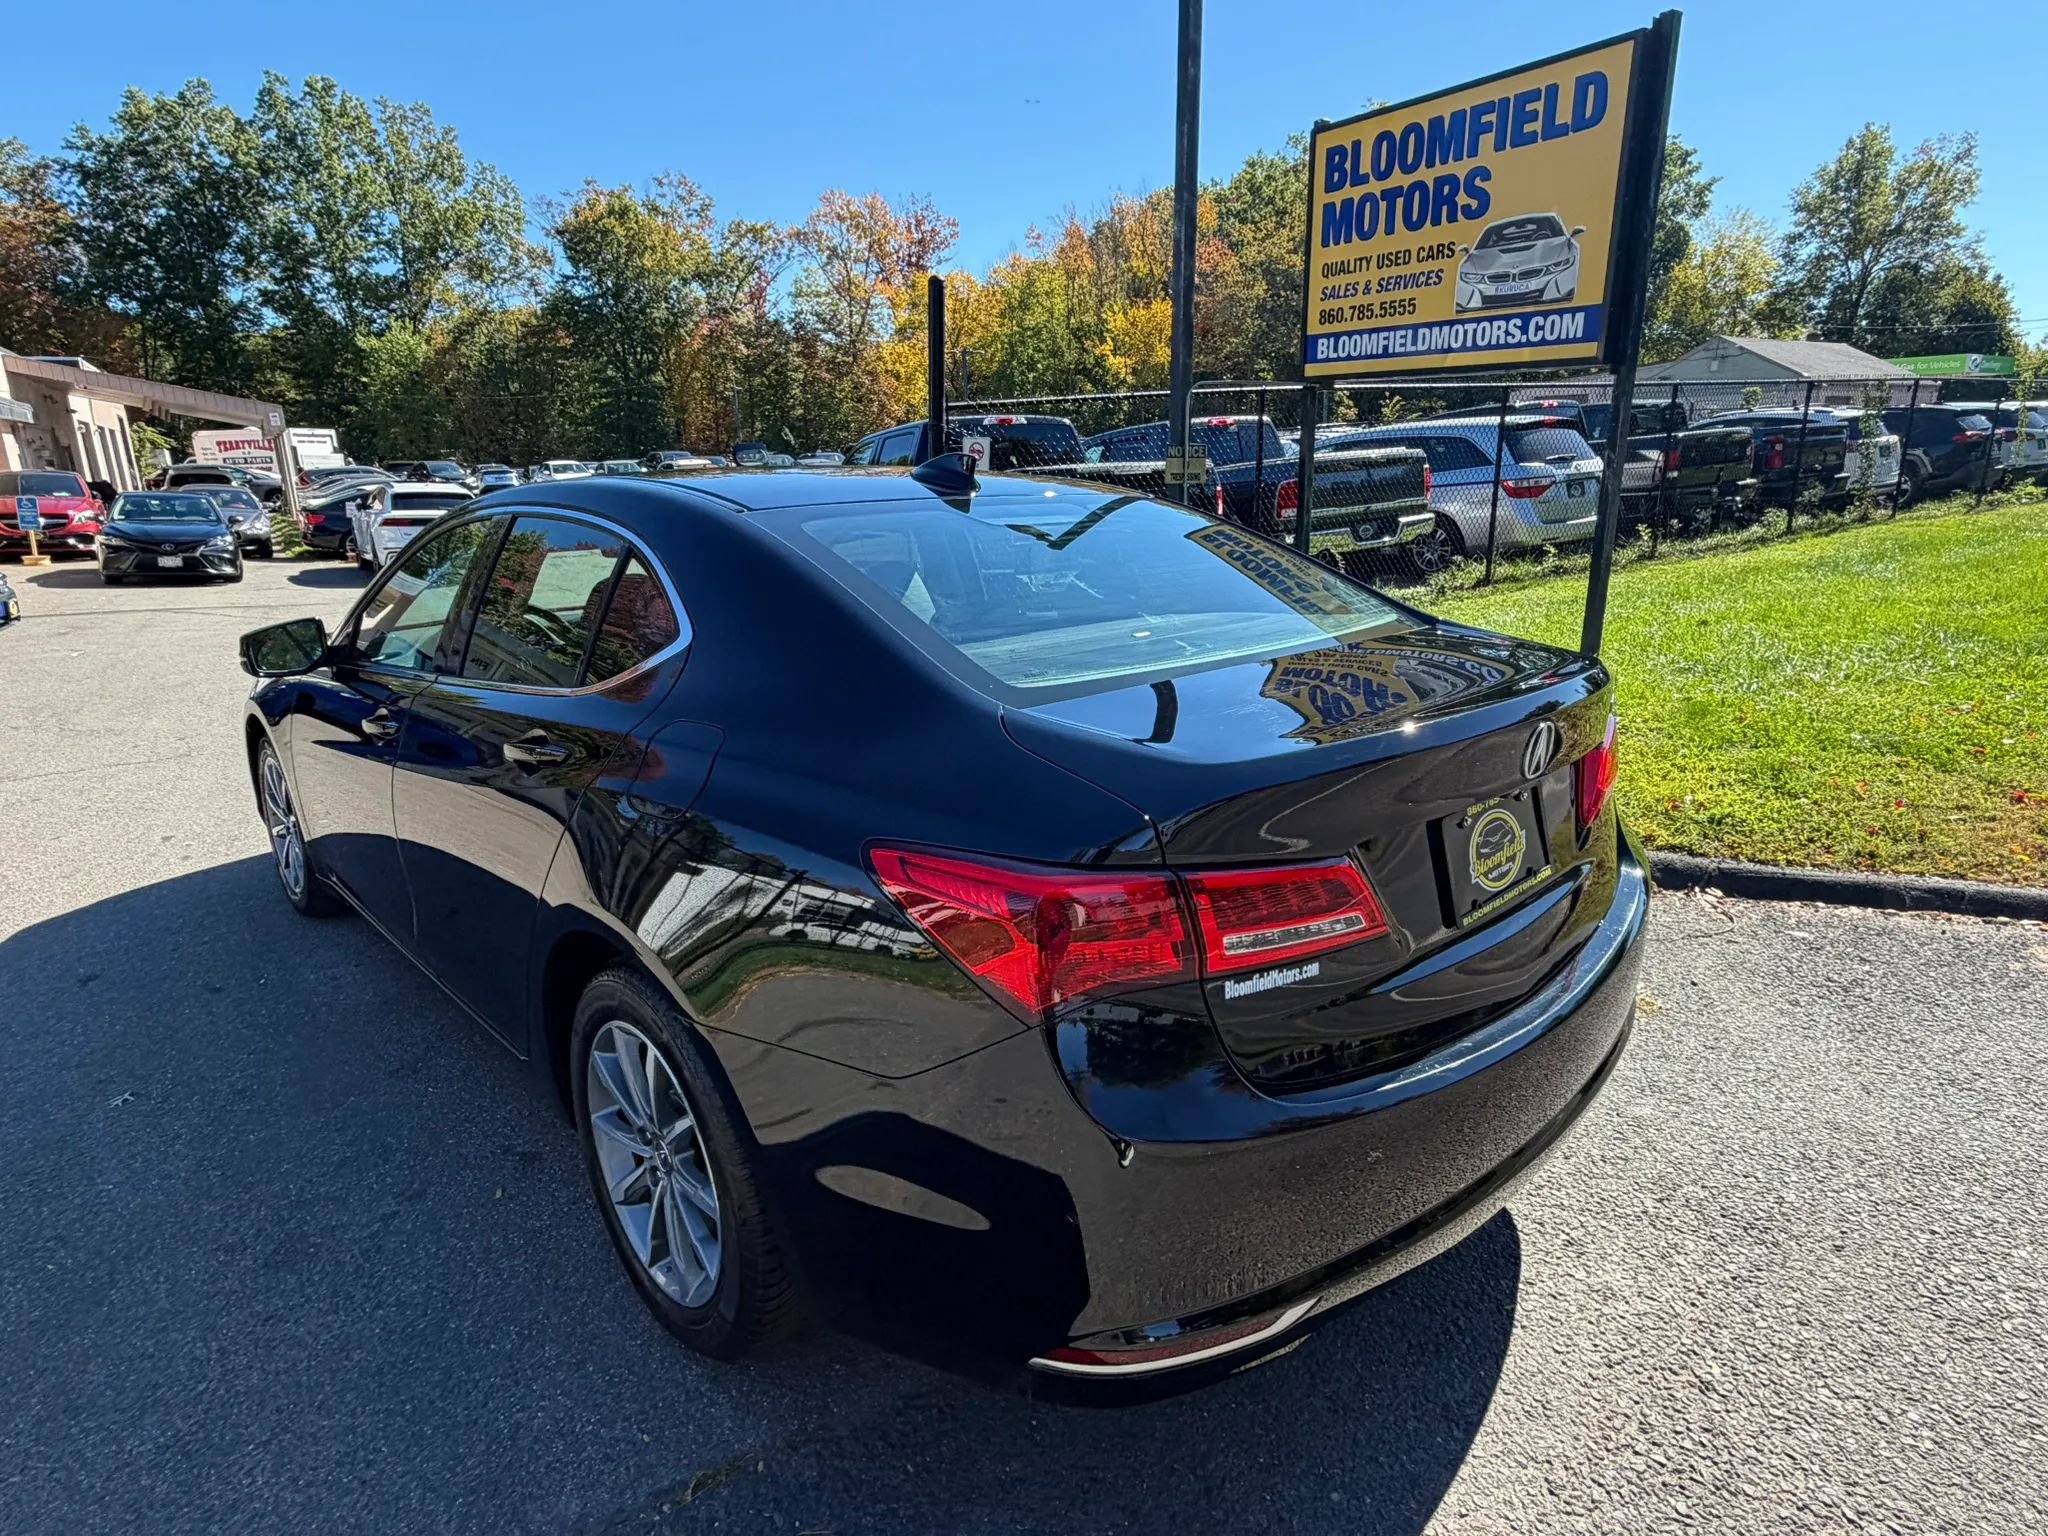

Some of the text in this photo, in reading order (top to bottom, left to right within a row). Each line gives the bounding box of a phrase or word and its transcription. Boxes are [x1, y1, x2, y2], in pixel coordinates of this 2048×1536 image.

[1323, 70, 1608, 194] BLOOMFIELD
[1320, 165, 1492, 248] MOTORS
[1322, 241, 1456, 278] QUALITY USED CARS
[1320, 268, 1444, 302] SALES & SERVICES
[1318, 298, 1417, 326] 860.785.5555
[1316, 311, 1586, 360] BLOOMFIELDMOTORS.COM
[1929, 360, 1961, 369] Vehicles
[216, 438, 274, 453] TERRYVILLE
[247, 456, 272, 464] PARTS
[1167, 445, 1206, 458] NOICE
[1474, 837, 1525, 877] Bloomfield
[1462, 867, 1553, 927] BLOOMFIELDMOTORS.COM
[1224, 962, 1320, 1000] BloomfieldMotors.com
